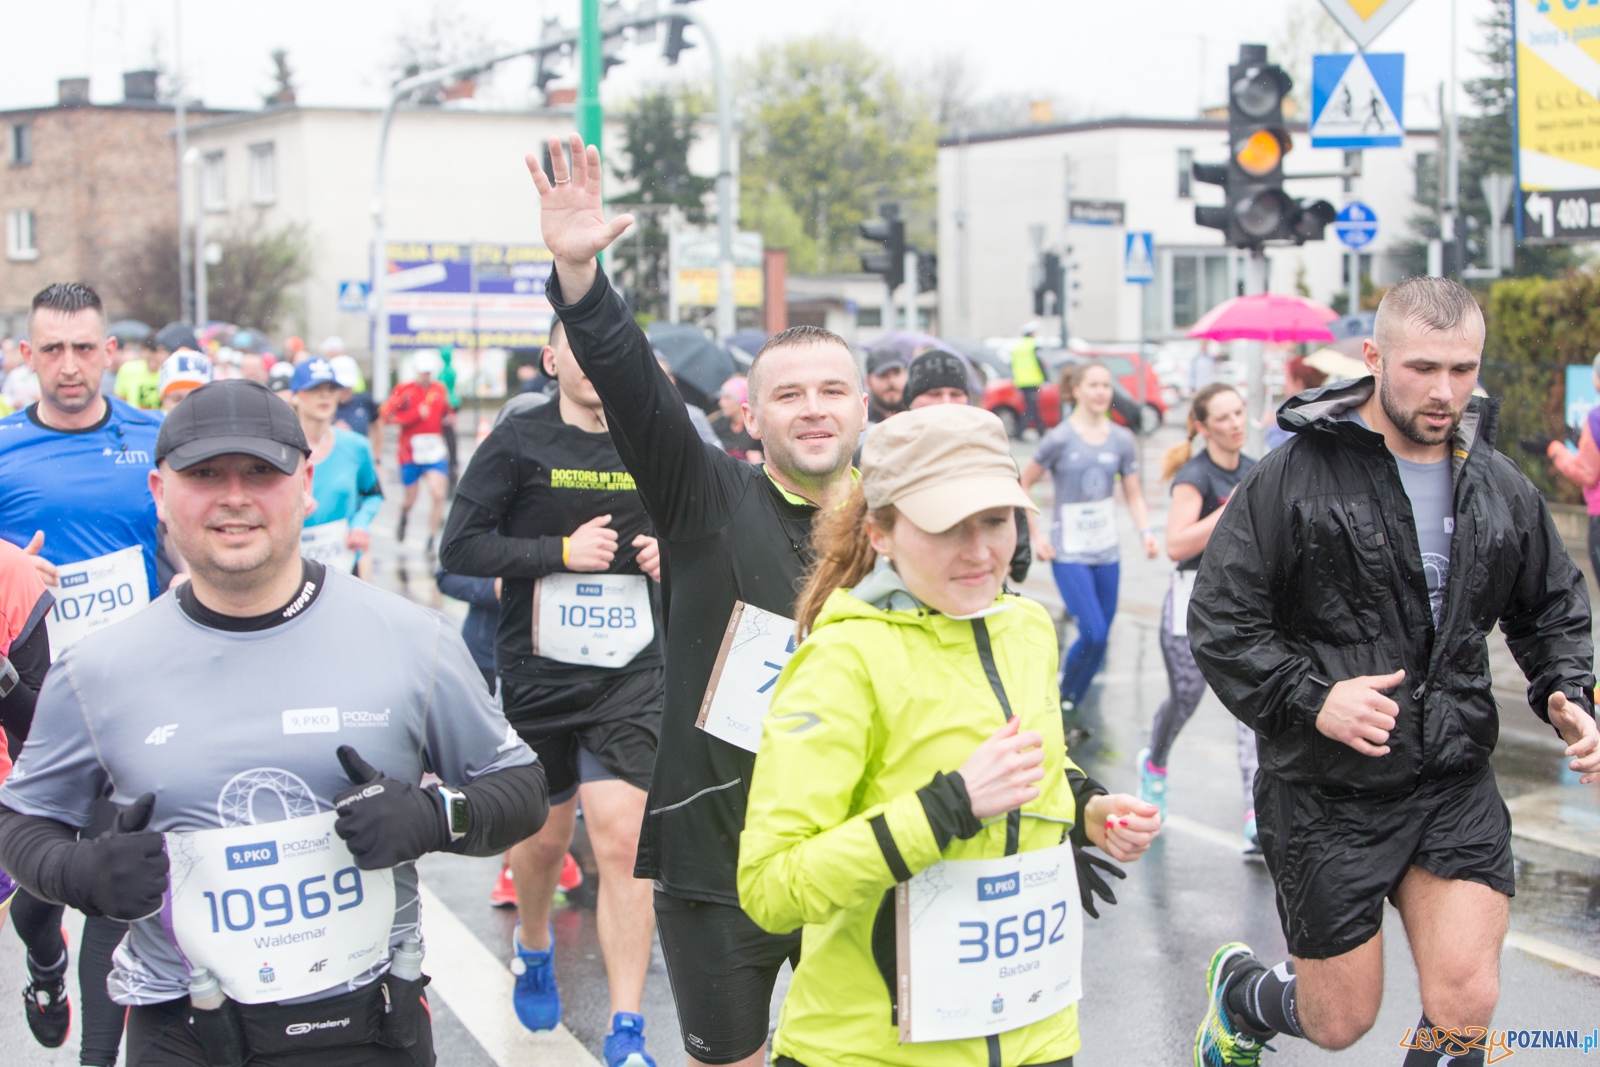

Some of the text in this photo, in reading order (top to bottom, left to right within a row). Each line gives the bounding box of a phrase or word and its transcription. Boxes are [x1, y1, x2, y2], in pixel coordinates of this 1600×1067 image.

[551, 469, 598, 482] DOCTORS
[599, 471, 611, 482] IN
[52, 583, 134, 623] 10790
[558, 604, 637, 629] 10583
[232, 847, 272, 864] 9.PKO
[983, 878, 1017, 896] 9.PKO
[203, 866, 364, 933] 10969
[254, 926, 327, 949] Waldemar
[958, 900, 1067, 964] 3692
[998, 959, 1040, 979] Barbara
[311, 1017, 351, 1031] Kalenji
